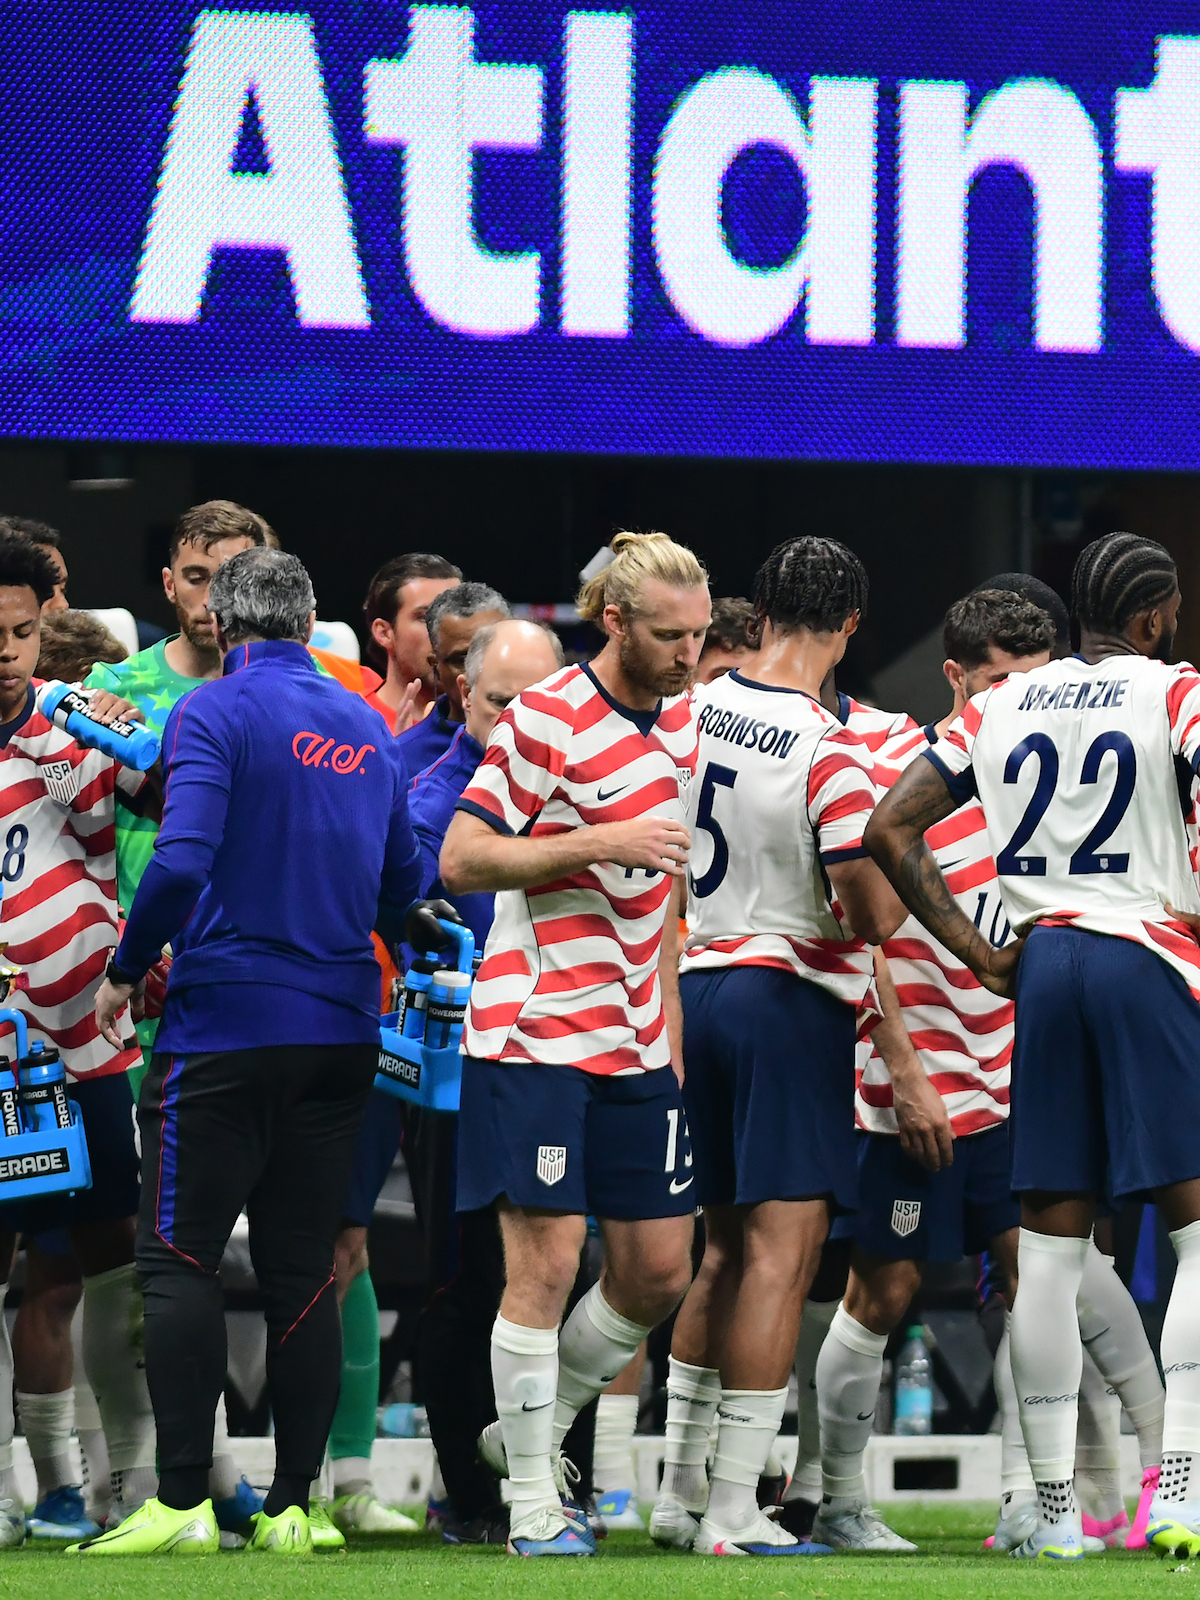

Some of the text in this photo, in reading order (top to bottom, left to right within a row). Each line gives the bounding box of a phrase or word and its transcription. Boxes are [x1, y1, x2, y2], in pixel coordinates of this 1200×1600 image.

[64, 693, 134, 737] POWADE
[700, 704, 800, 759] ROBINSON
[43, 763, 70, 780] USA
[677, 769, 690, 787] USA
[997, 731, 1136, 876] 22
[690, 761, 738, 898] 5
[3, 824, 29, 882] 8
[974, 892, 1011, 948] 10
[429, 1006, 466, 1018] POWERAD
[541, 1148, 563, 1162] USA
[895, 1201, 919, 1216] USA
